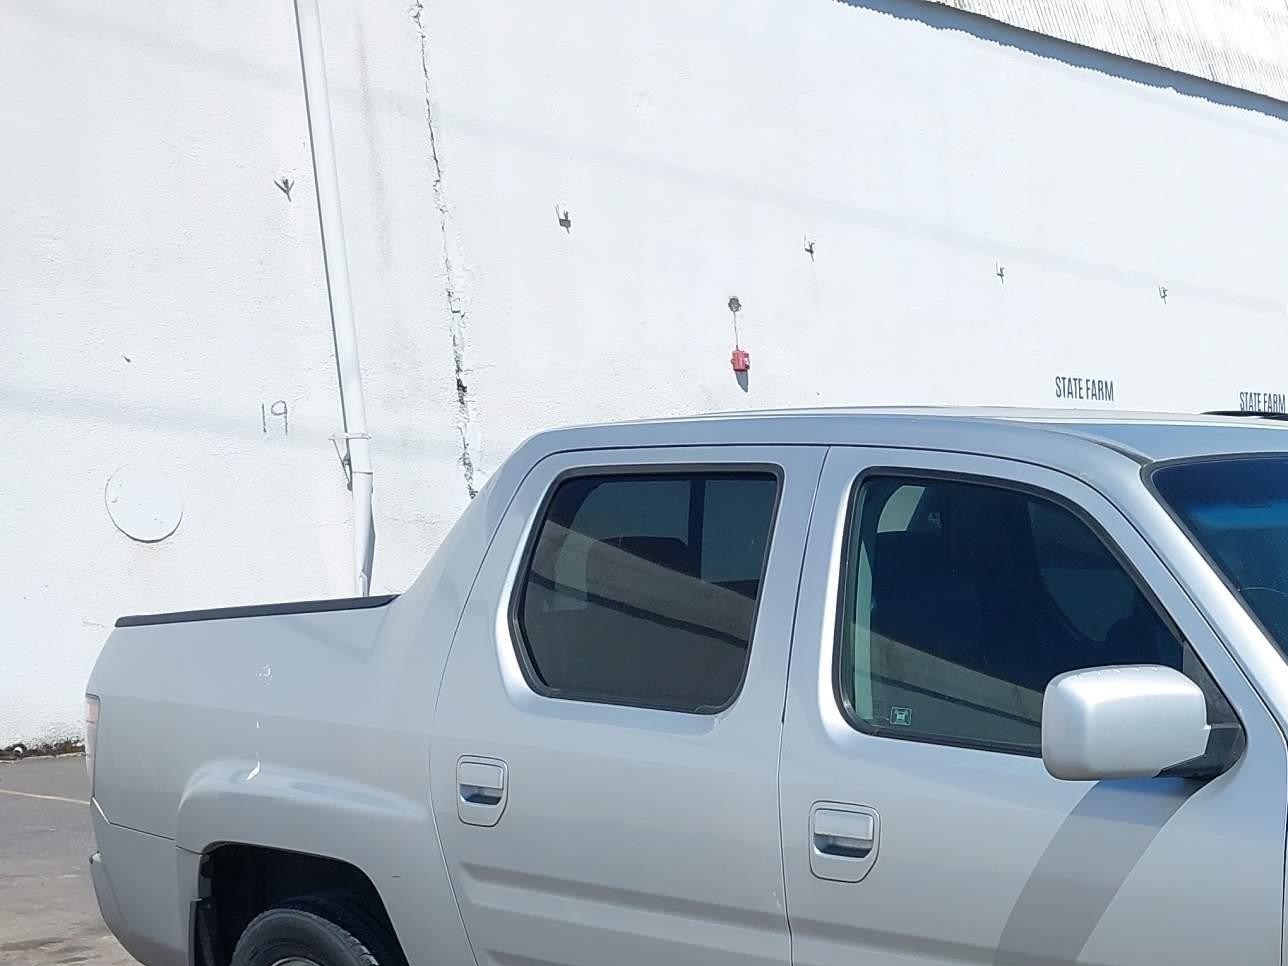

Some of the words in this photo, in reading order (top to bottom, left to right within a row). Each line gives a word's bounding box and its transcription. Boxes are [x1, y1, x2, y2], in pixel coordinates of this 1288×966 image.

[1055, 376, 1084, 399] STATE
[1086, 379, 1114, 401] FARM
[1240, 391, 1261, 411] STATE
[1263, 393, 1286, 413] FARM
